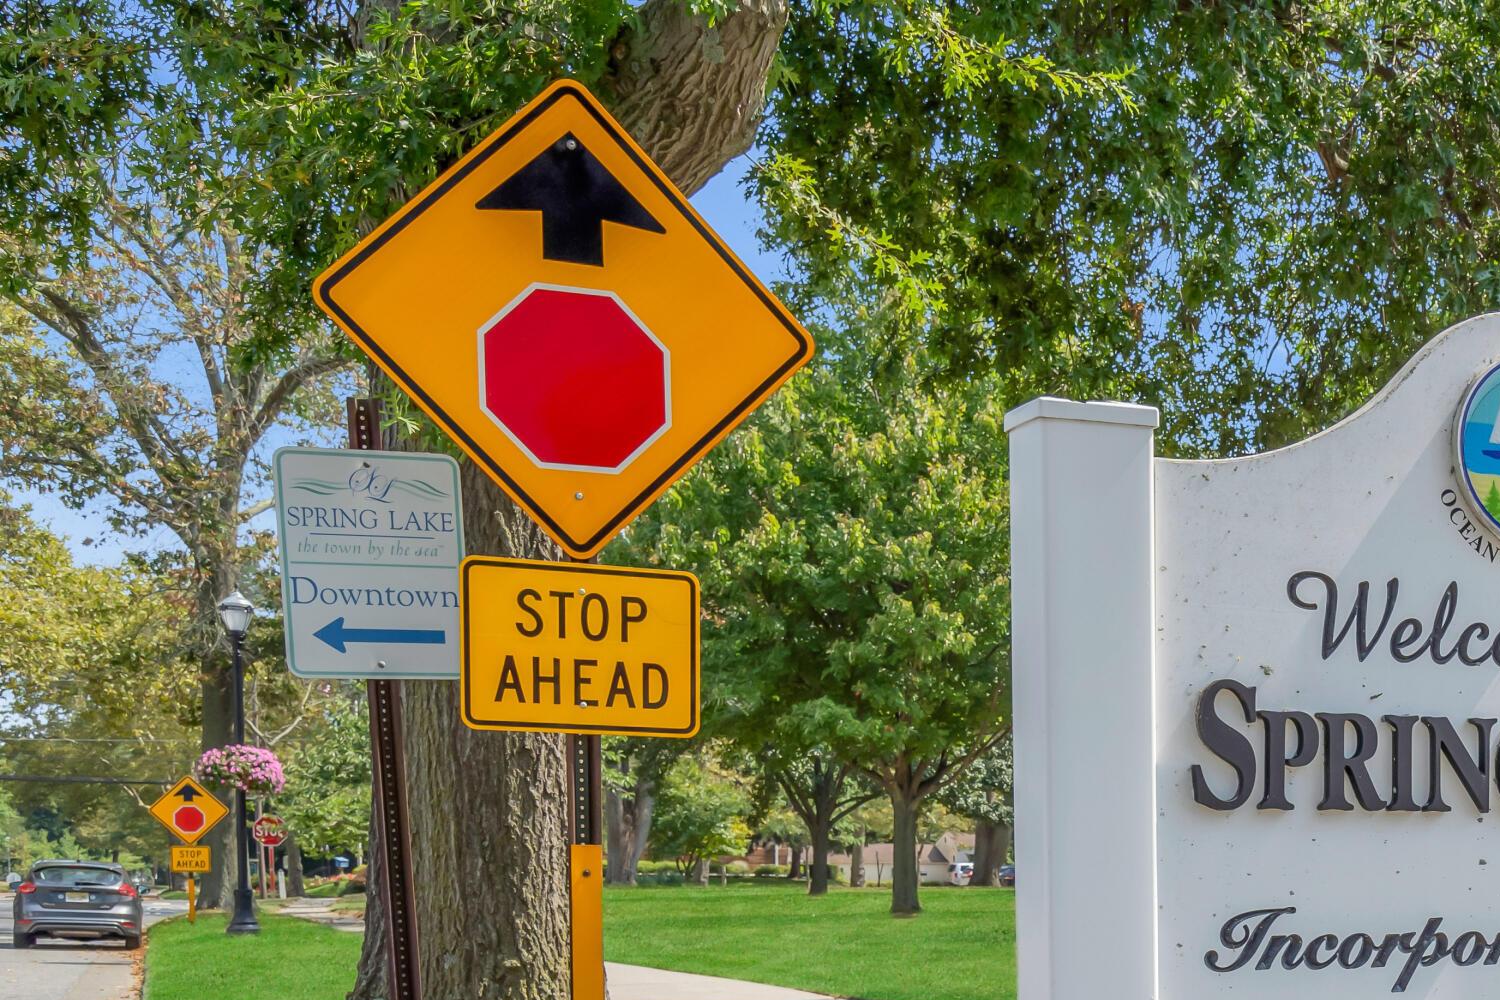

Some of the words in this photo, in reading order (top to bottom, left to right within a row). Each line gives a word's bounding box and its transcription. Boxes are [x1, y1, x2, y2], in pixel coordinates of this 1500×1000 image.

[287, 506, 378, 530] SPRING
[389, 510, 455, 532] LAKE
[297, 537, 318, 554] the
[324, 541, 361, 555] town
[368, 540, 384, 560] by
[390, 540, 411, 556] the
[290, 576, 460, 608] Downtown
[515, 588, 648, 643] STOP
[494, 655, 669, 710] AHEAD
[176, 860, 206, 869] AHEAD
[179, 850, 202, 859] STOP
